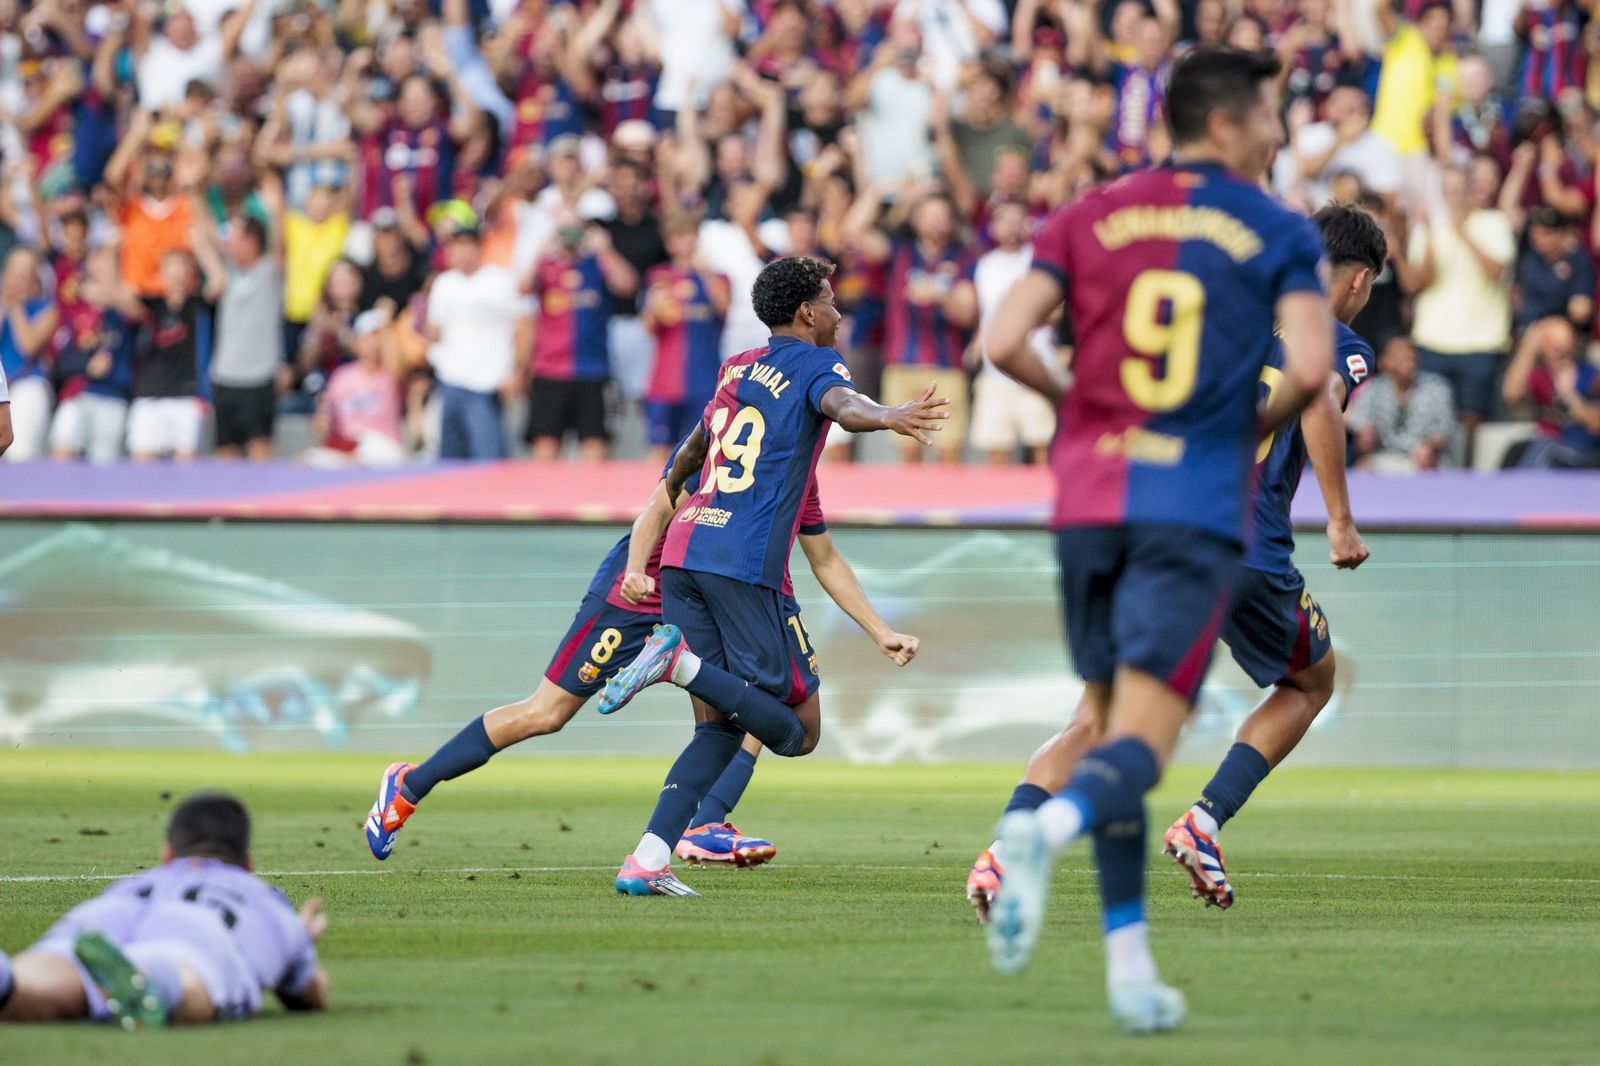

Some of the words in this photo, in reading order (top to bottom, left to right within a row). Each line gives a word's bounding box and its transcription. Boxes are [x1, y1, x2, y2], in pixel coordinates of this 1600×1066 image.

[1121, 268, 1206, 412] 9
[748, 362, 790, 399] YAMAL
[700, 405, 765, 493] 19
[590, 627, 623, 664] 8
[788, 613, 815, 654] 1
